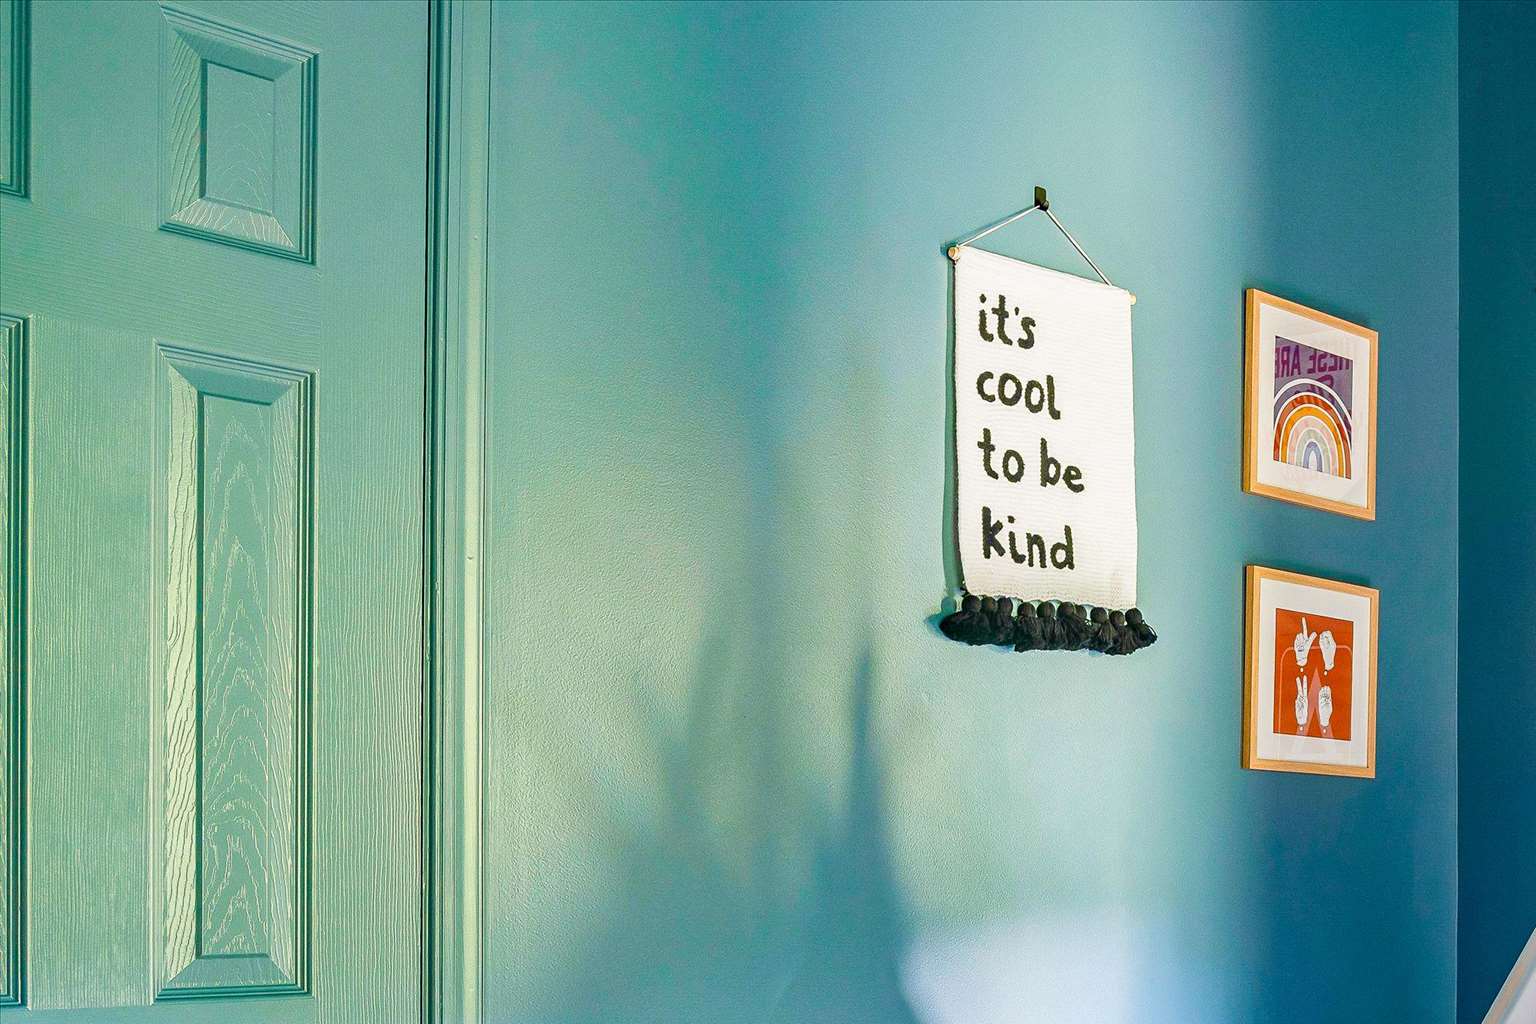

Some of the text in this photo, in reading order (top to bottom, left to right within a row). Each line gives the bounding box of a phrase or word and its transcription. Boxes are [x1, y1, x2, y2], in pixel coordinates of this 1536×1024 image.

[978, 294, 1037, 349] it's
[977, 371, 1061, 420] cool
[977, 427, 1084, 493] to be
[981, 506, 1075, 570] kind
